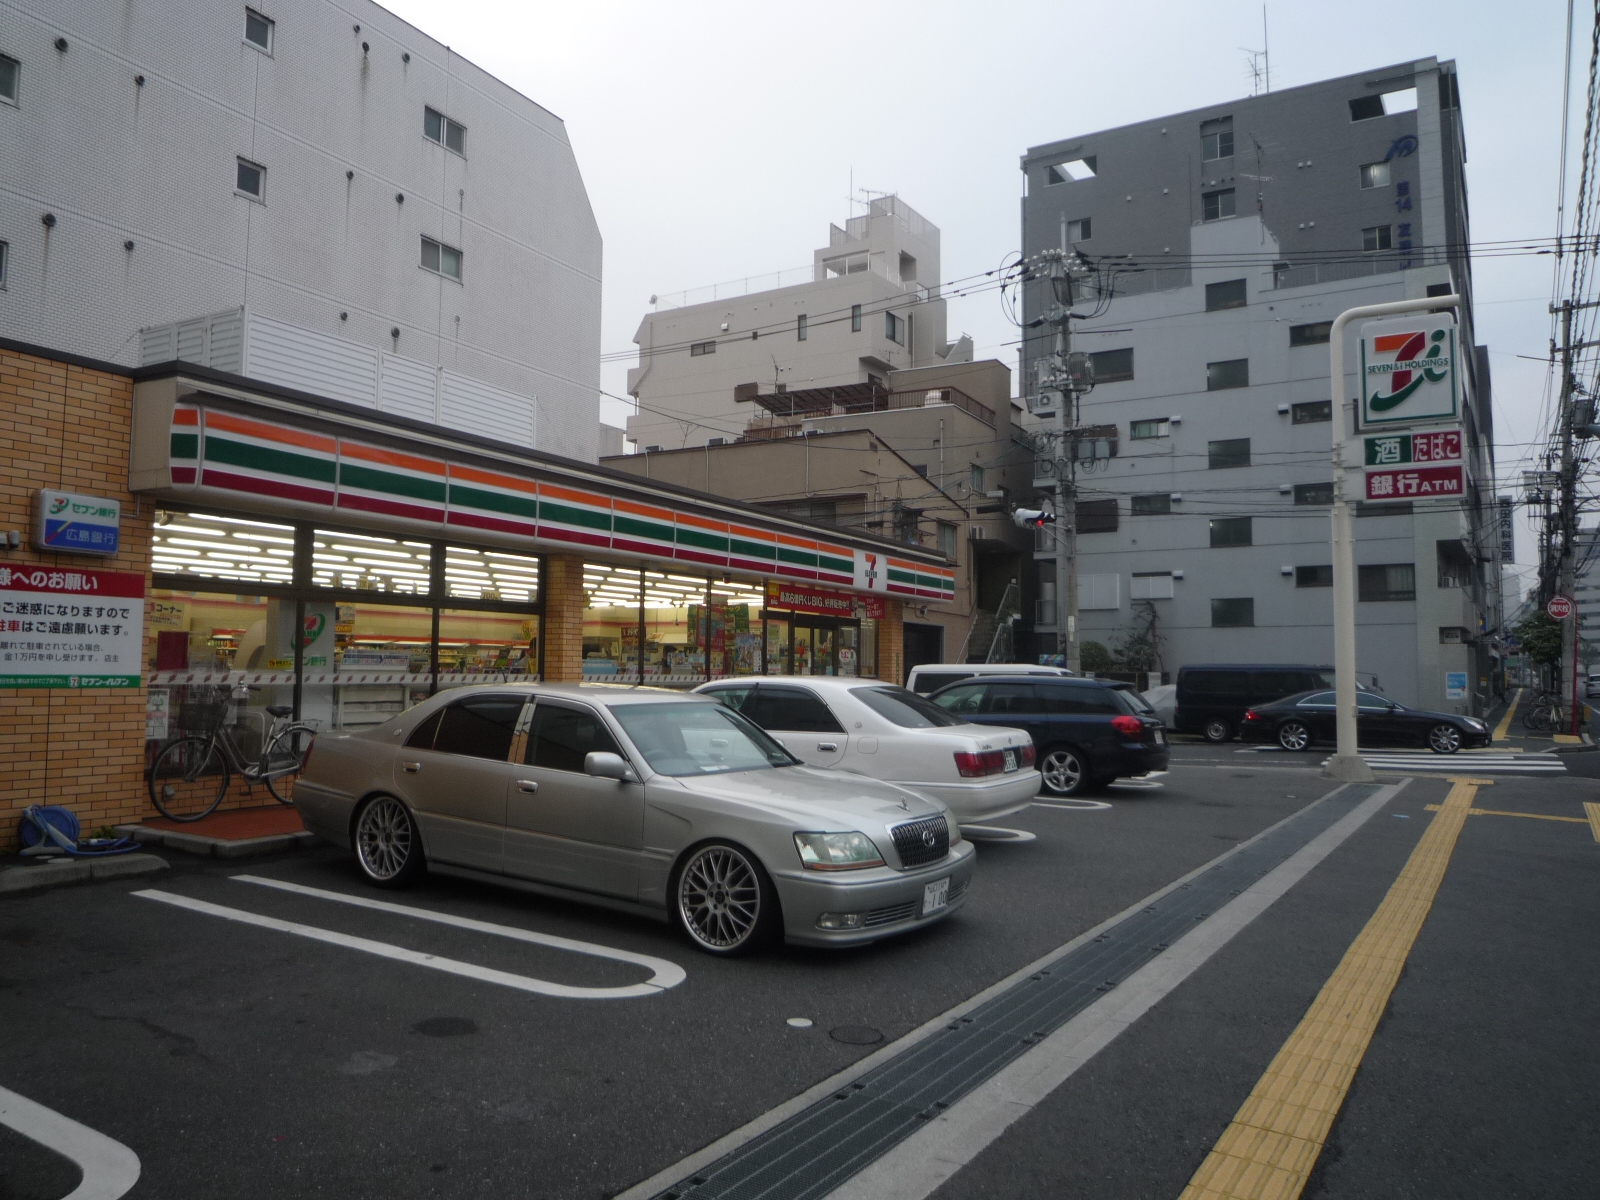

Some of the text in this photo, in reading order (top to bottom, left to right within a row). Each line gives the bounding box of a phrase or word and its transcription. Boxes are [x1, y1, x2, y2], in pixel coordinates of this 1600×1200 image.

[1405, 357, 1449, 369] HOLDINGS
[1374, 437, 1400, 464] 酒
[1414, 433, 1461, 462] たばこ
[72, 502, 117, 519] セブン銀行
[65, 527, 115, 546] 広島銀行
[3, 601, 130, 619] ご迷惑になりますので
[104, 654, 119, 663] 店主
